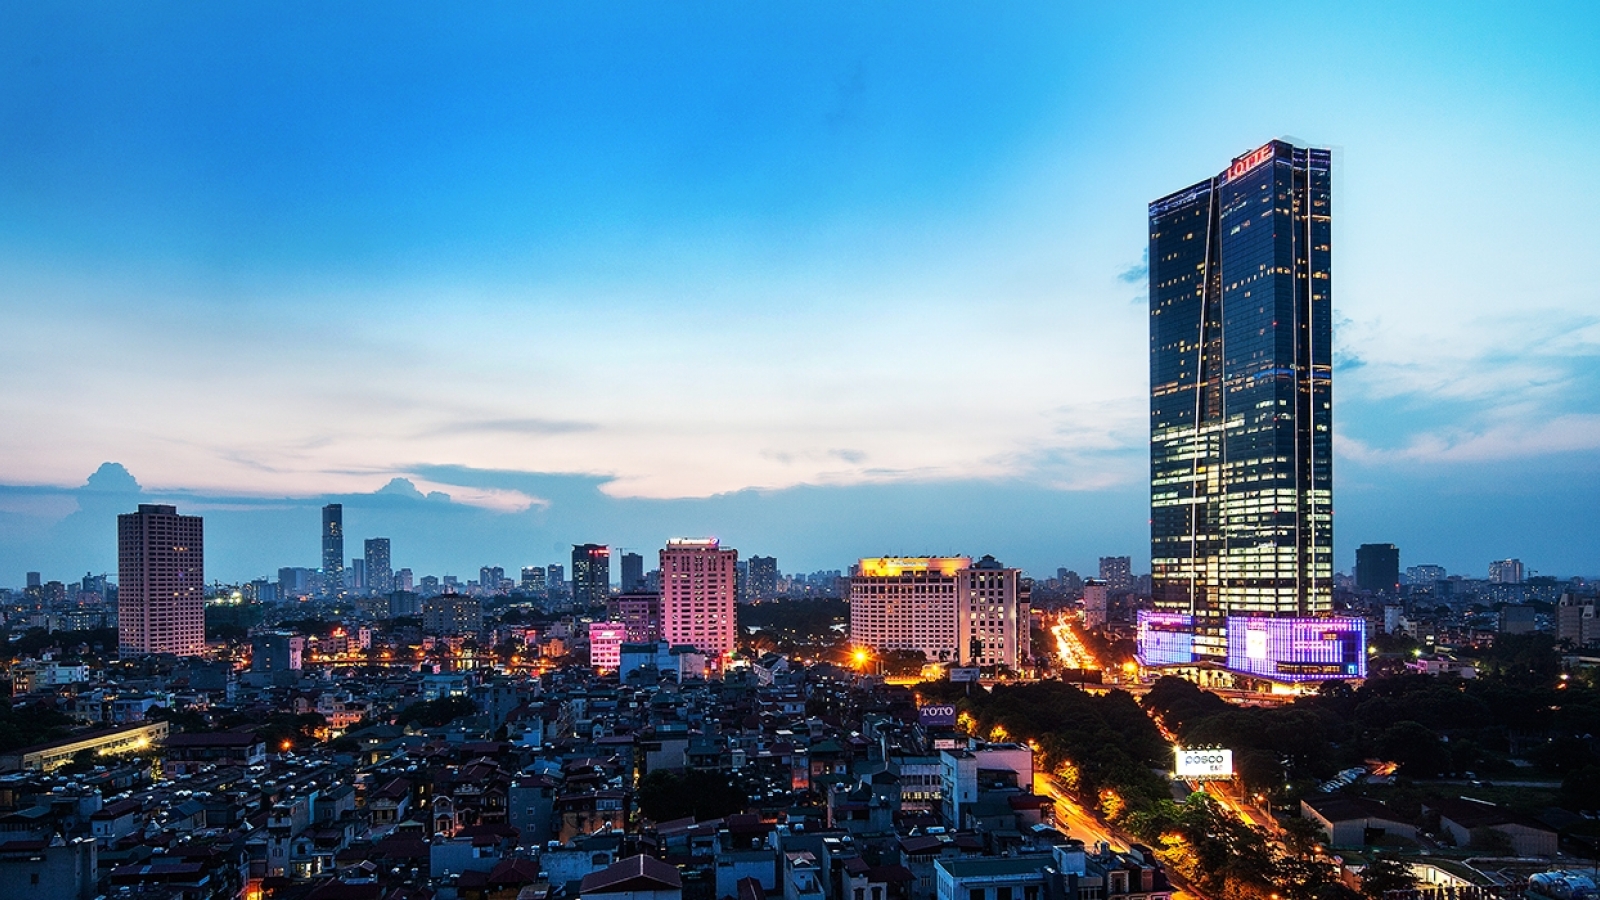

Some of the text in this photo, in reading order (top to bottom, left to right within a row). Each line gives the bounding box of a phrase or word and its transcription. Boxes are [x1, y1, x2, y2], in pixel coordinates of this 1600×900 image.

[1227, 144, 1272, 182] LOTTE
[921, 706, 954, 717] TOTO
[1185, 755, 1224, 767] posco
